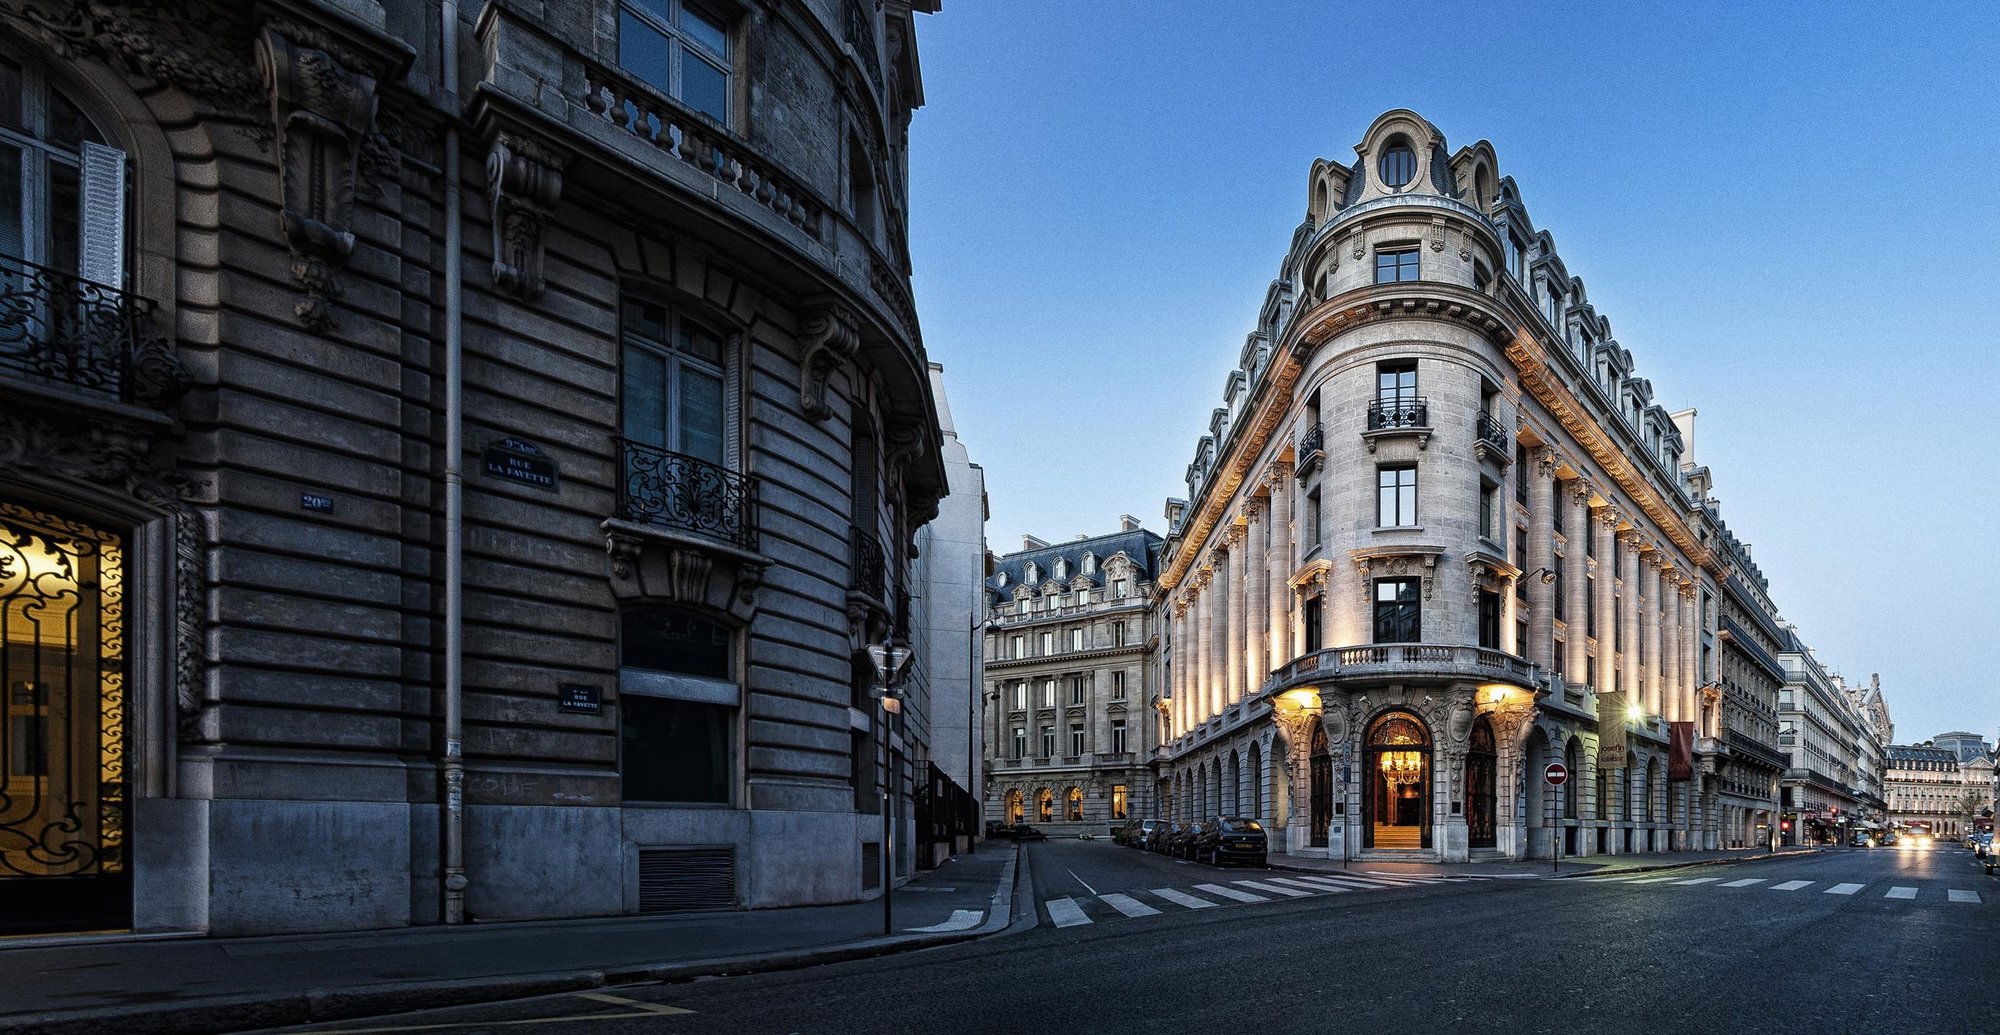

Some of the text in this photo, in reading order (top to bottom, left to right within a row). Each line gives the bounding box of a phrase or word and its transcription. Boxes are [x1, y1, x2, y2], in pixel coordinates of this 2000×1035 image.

[509, 458, 532, 470] RUE
[488, 462, 552, 485] LA FAYETTE
[573, 701, 598, 709] FAYETTE
